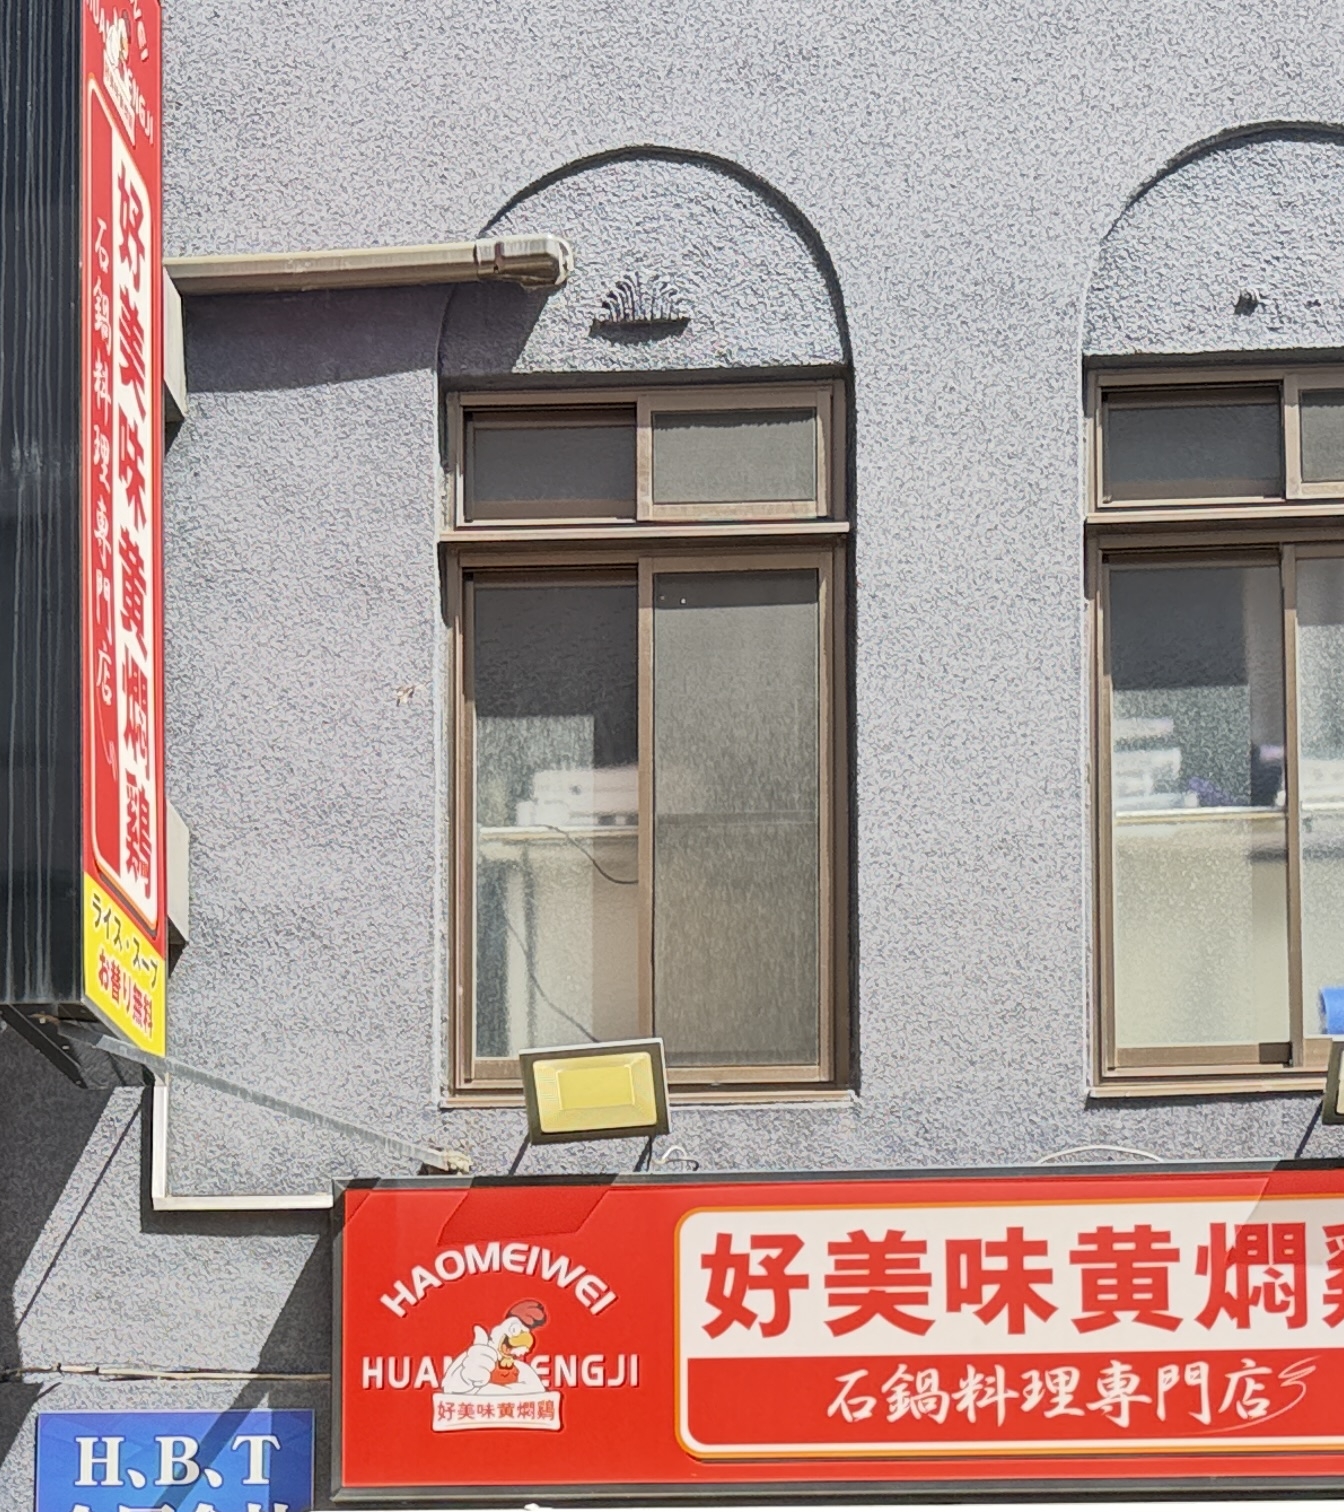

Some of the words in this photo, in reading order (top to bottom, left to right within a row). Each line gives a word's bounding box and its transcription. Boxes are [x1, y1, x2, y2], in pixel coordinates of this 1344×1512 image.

[98, 948, 153, 1039] お替り無料
[380, 1241, 617, 1318] HAOMEIWEI
[827, 1357, 1274, 1428] 石鍋料理専門店
